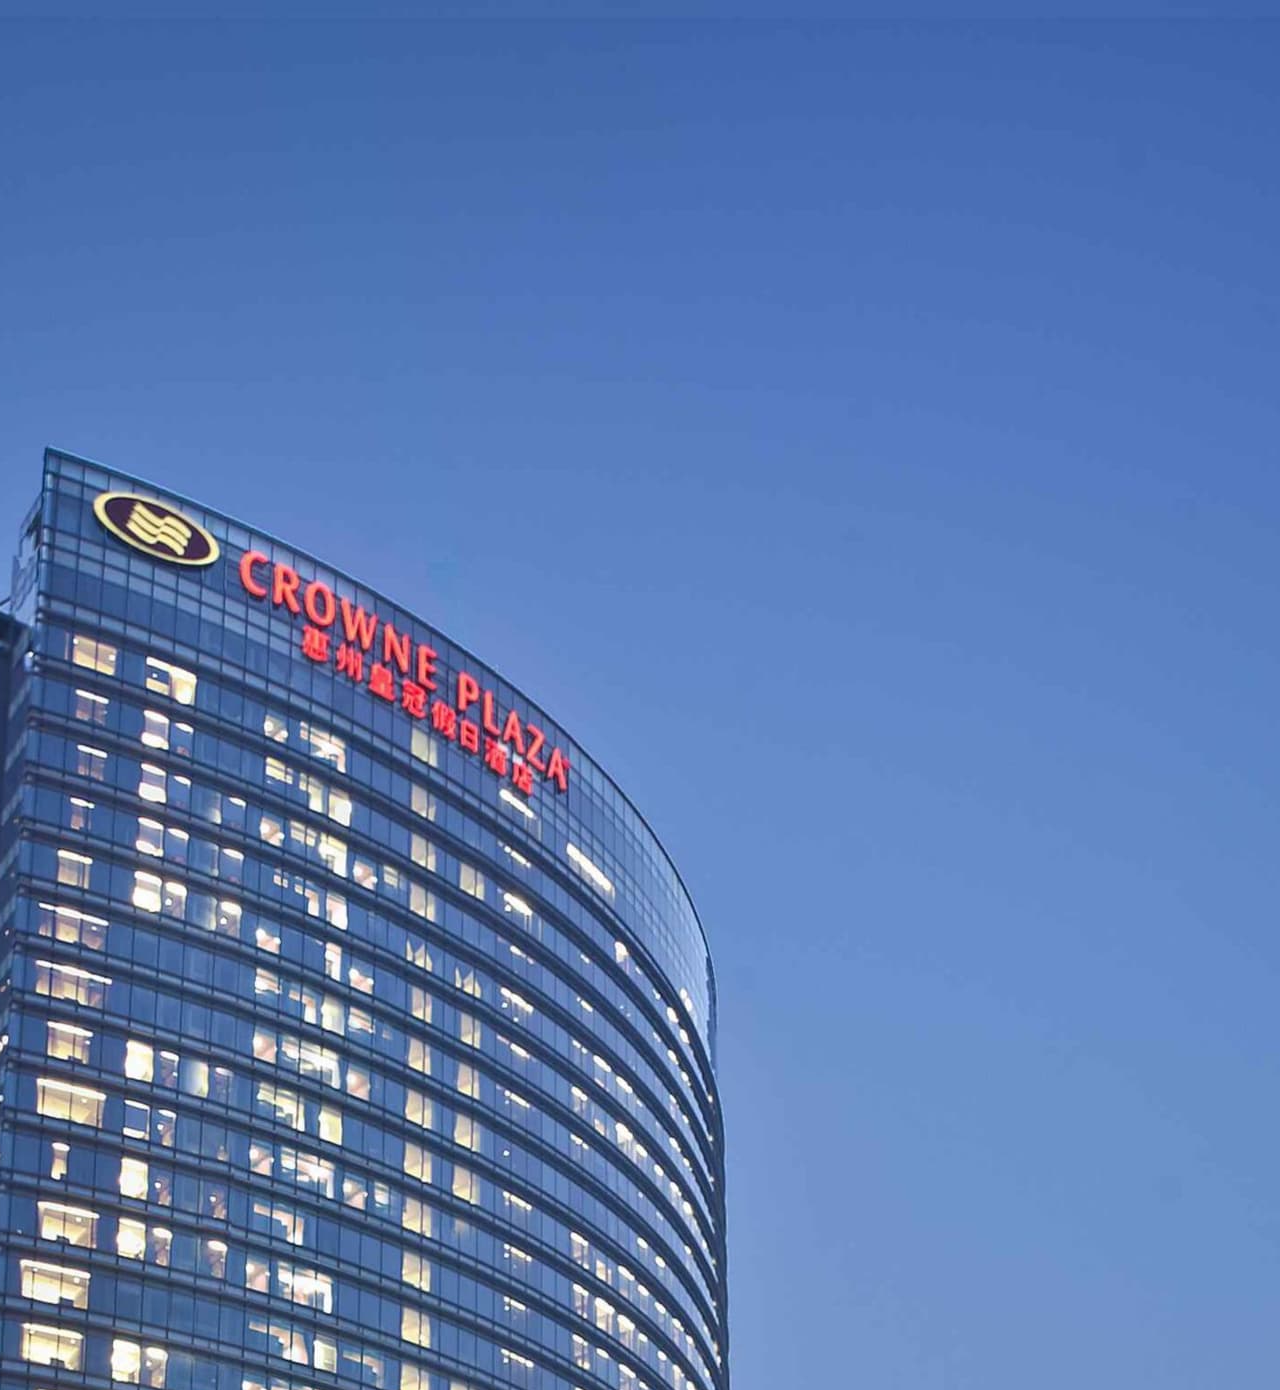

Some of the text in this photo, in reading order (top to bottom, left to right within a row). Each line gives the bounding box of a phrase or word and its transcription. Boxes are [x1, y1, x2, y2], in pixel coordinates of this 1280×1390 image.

[239, 549, 569, 793] CROWNE PLAZA
[302, 624, 535, 797] 惠州皇冠假日酒店
